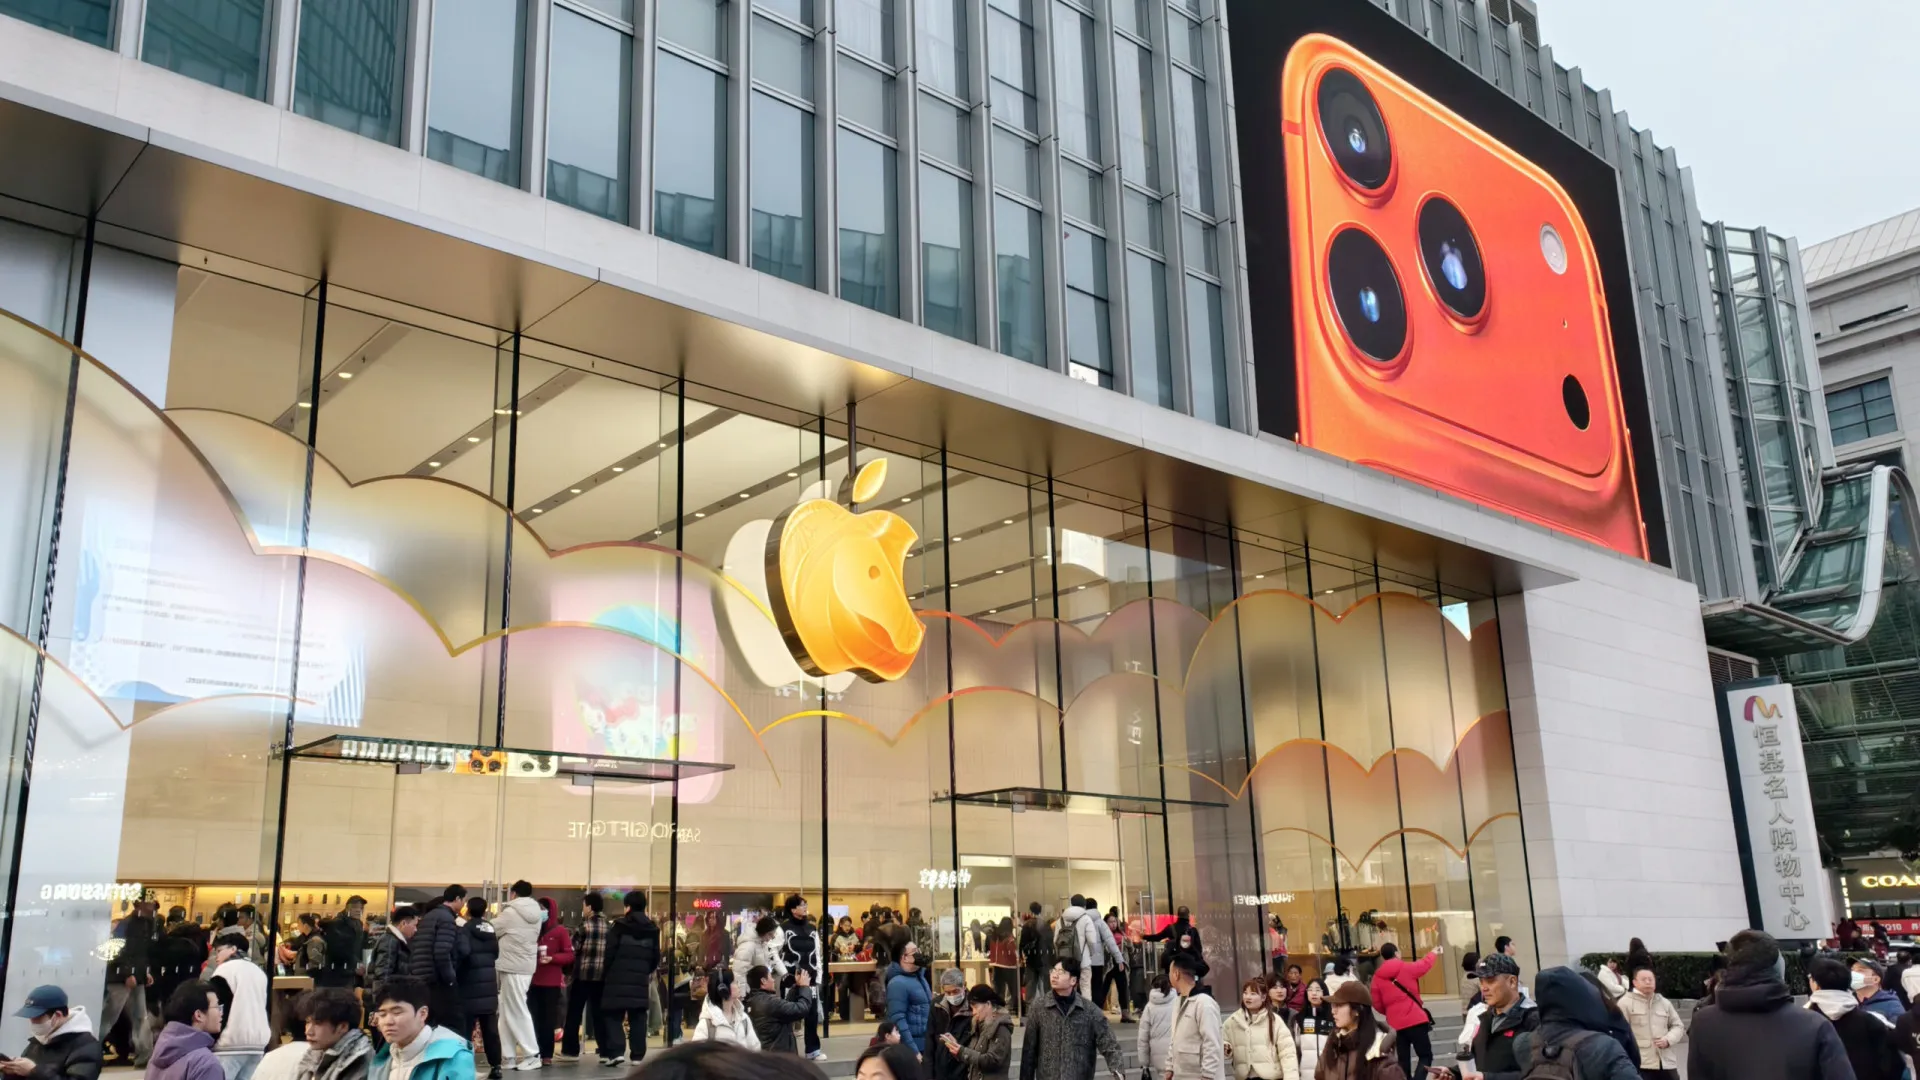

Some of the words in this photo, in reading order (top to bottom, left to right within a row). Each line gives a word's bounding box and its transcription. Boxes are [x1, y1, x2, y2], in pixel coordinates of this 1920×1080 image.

[1753, 724, 1810, 931] 恒基名人购物中心
[699, 899, 721, 908] Music
